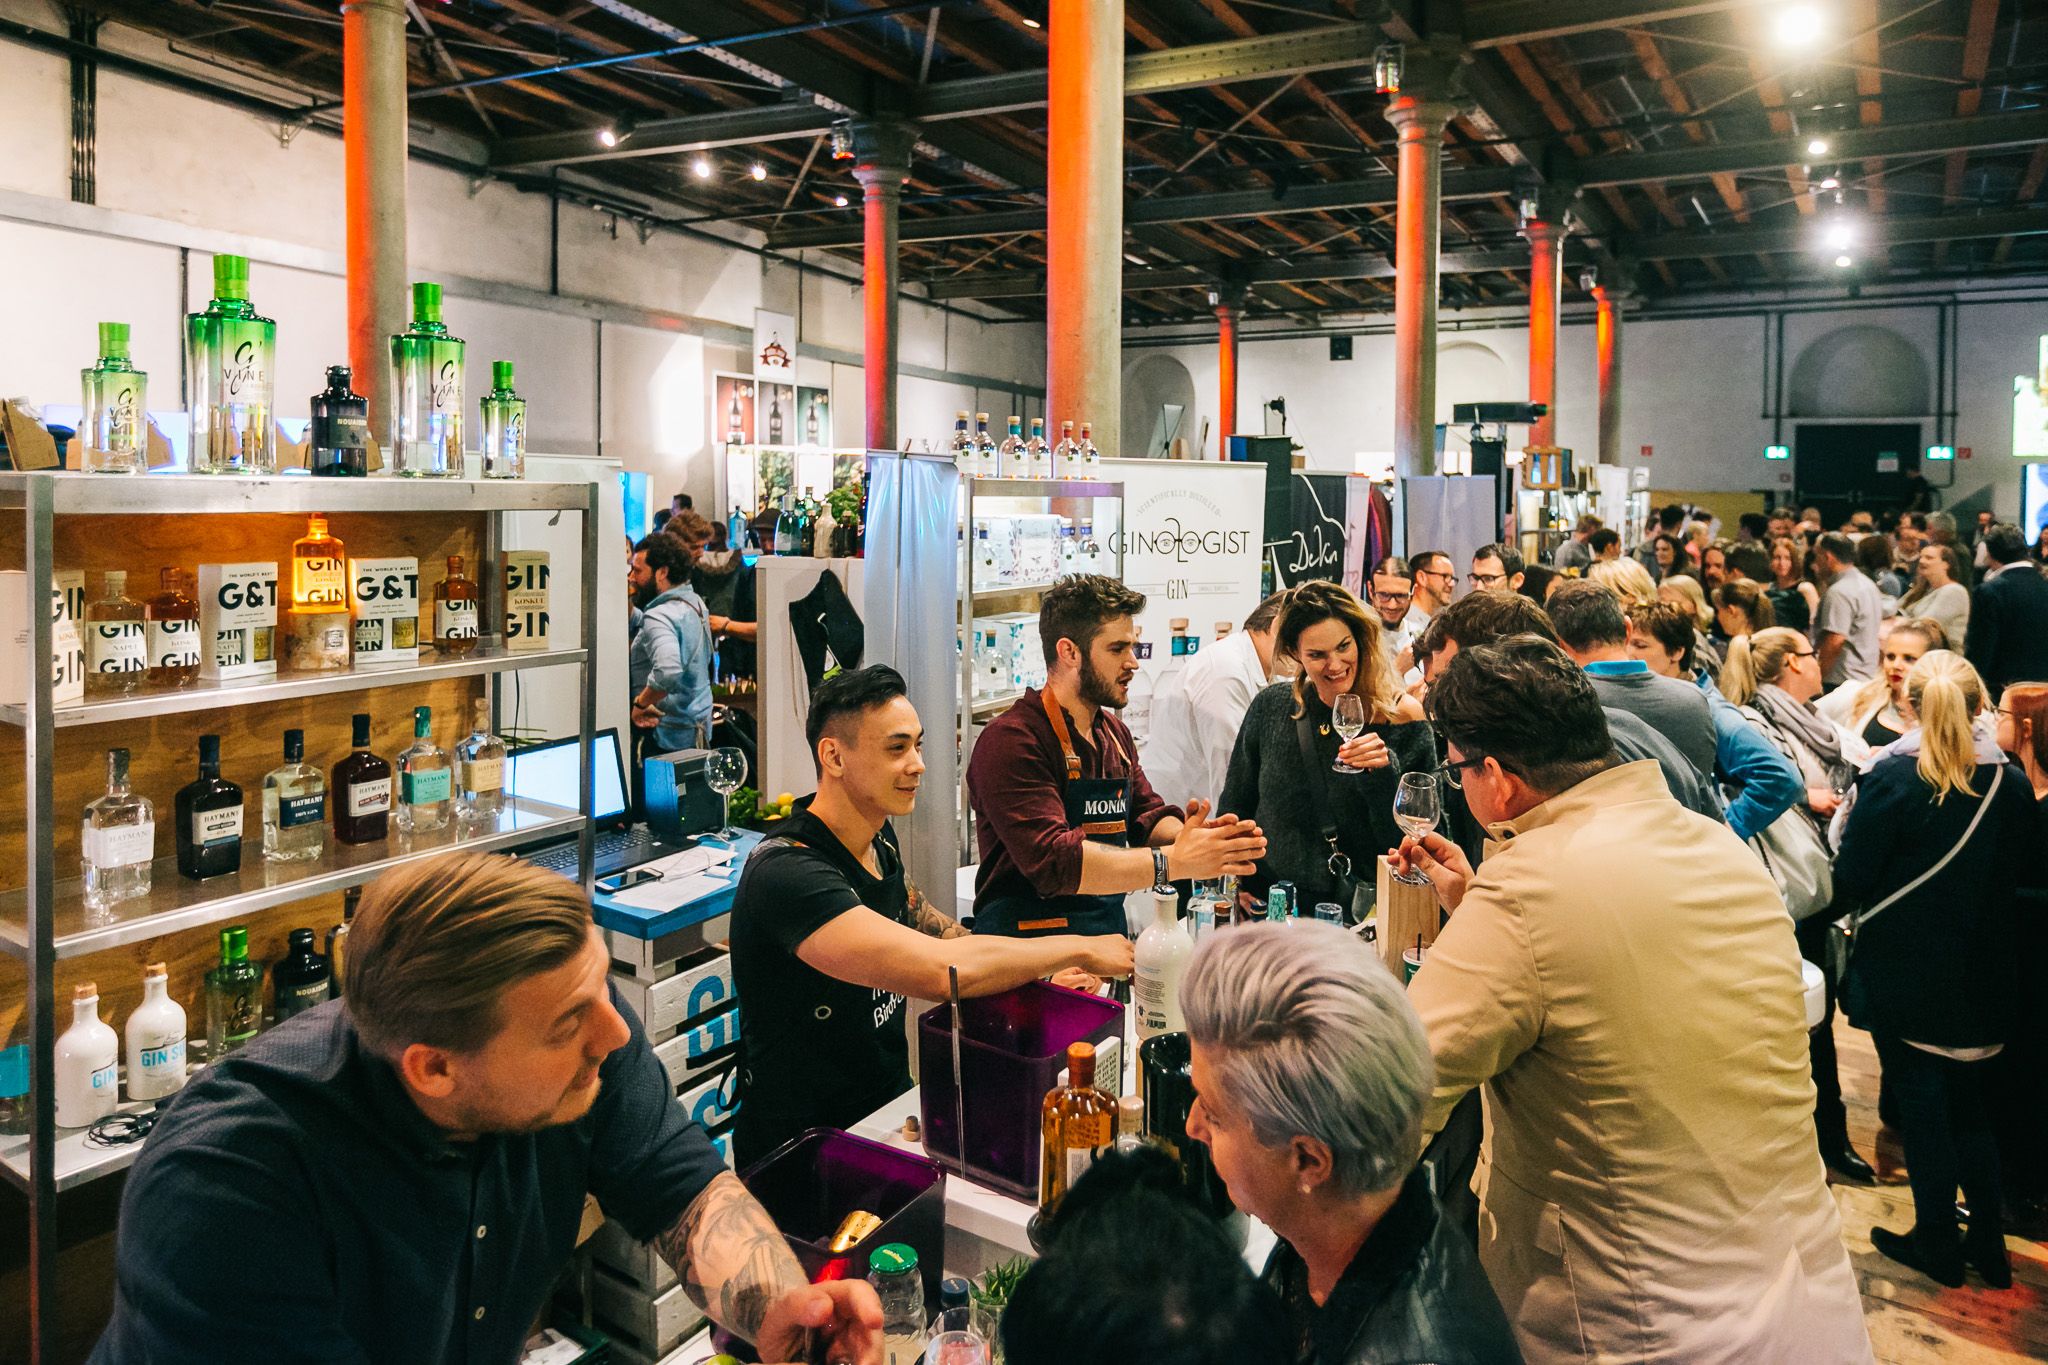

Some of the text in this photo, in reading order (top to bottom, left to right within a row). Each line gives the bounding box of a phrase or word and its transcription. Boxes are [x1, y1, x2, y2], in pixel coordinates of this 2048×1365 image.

[218, 580, 278, 610] G&T
[357, 574, 418, 602] G&T
[1166, 579, 1190, 601] GIN
[1084, 798, 1127, 815] MONIN
[141, 1050, 168, 1067] GIN
